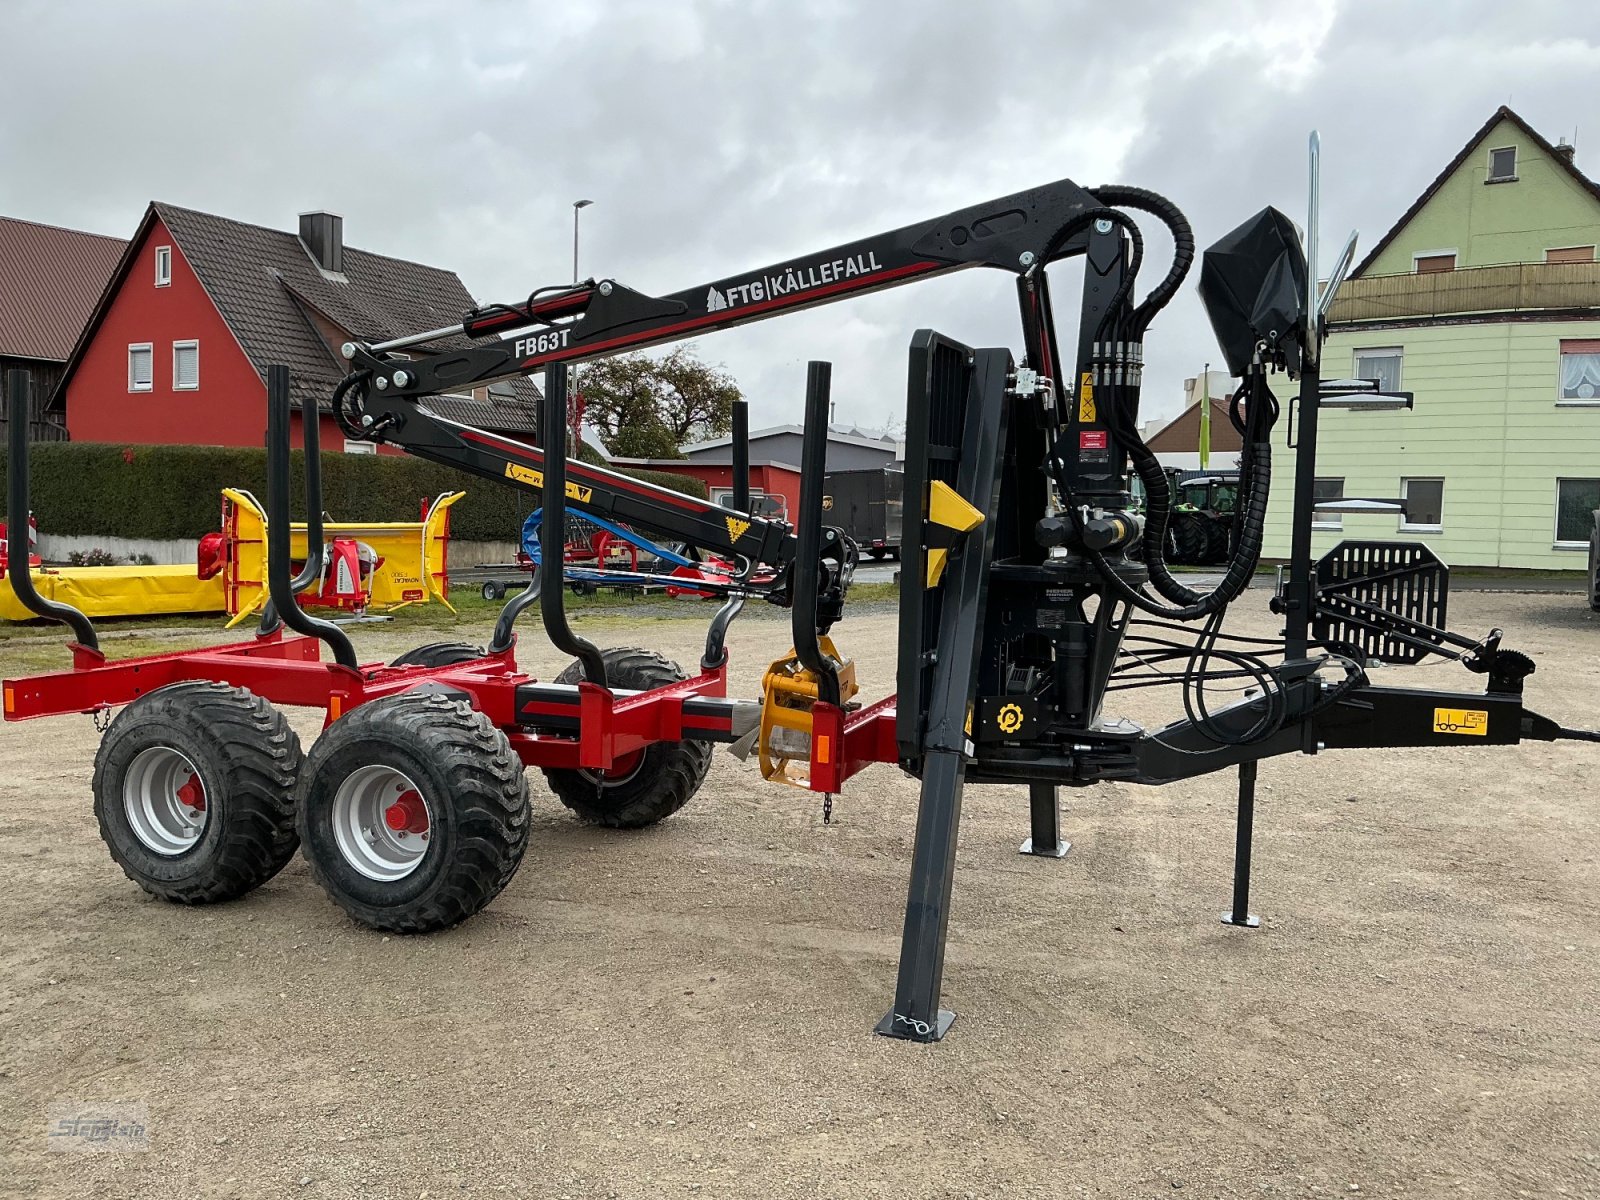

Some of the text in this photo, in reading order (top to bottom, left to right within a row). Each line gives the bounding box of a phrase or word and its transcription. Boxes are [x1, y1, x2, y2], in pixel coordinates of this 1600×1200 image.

[726, 251, 882, 307] FTG KÄLLEFALL
[515, 328, 571, 359] FB63T
